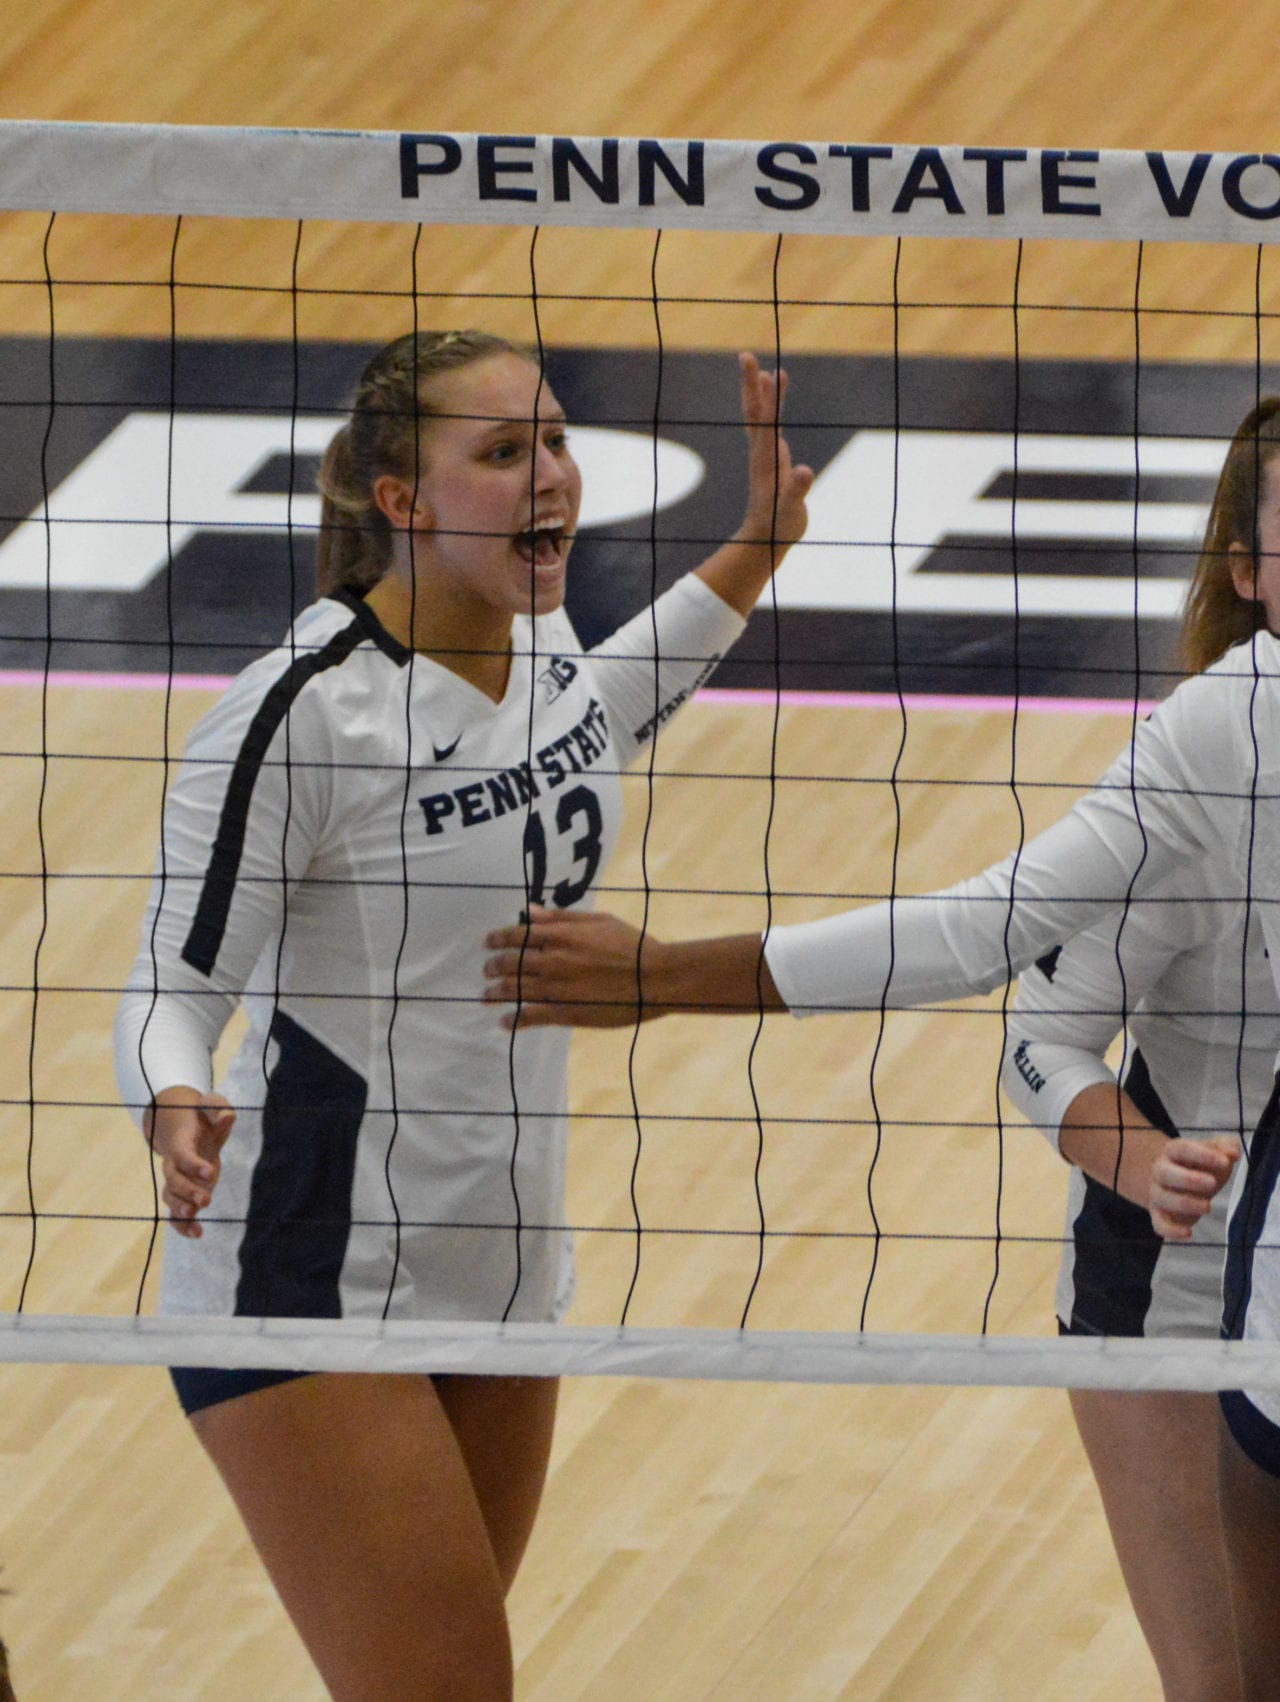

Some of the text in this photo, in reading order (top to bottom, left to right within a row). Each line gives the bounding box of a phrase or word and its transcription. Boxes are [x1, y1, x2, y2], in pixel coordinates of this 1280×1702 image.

[399, 134, 705, 207] PENN
[754, 143, 1102, 217] STATE
[418, 760, 541, 836] PENN
[520, 784, 604, 926] 13
